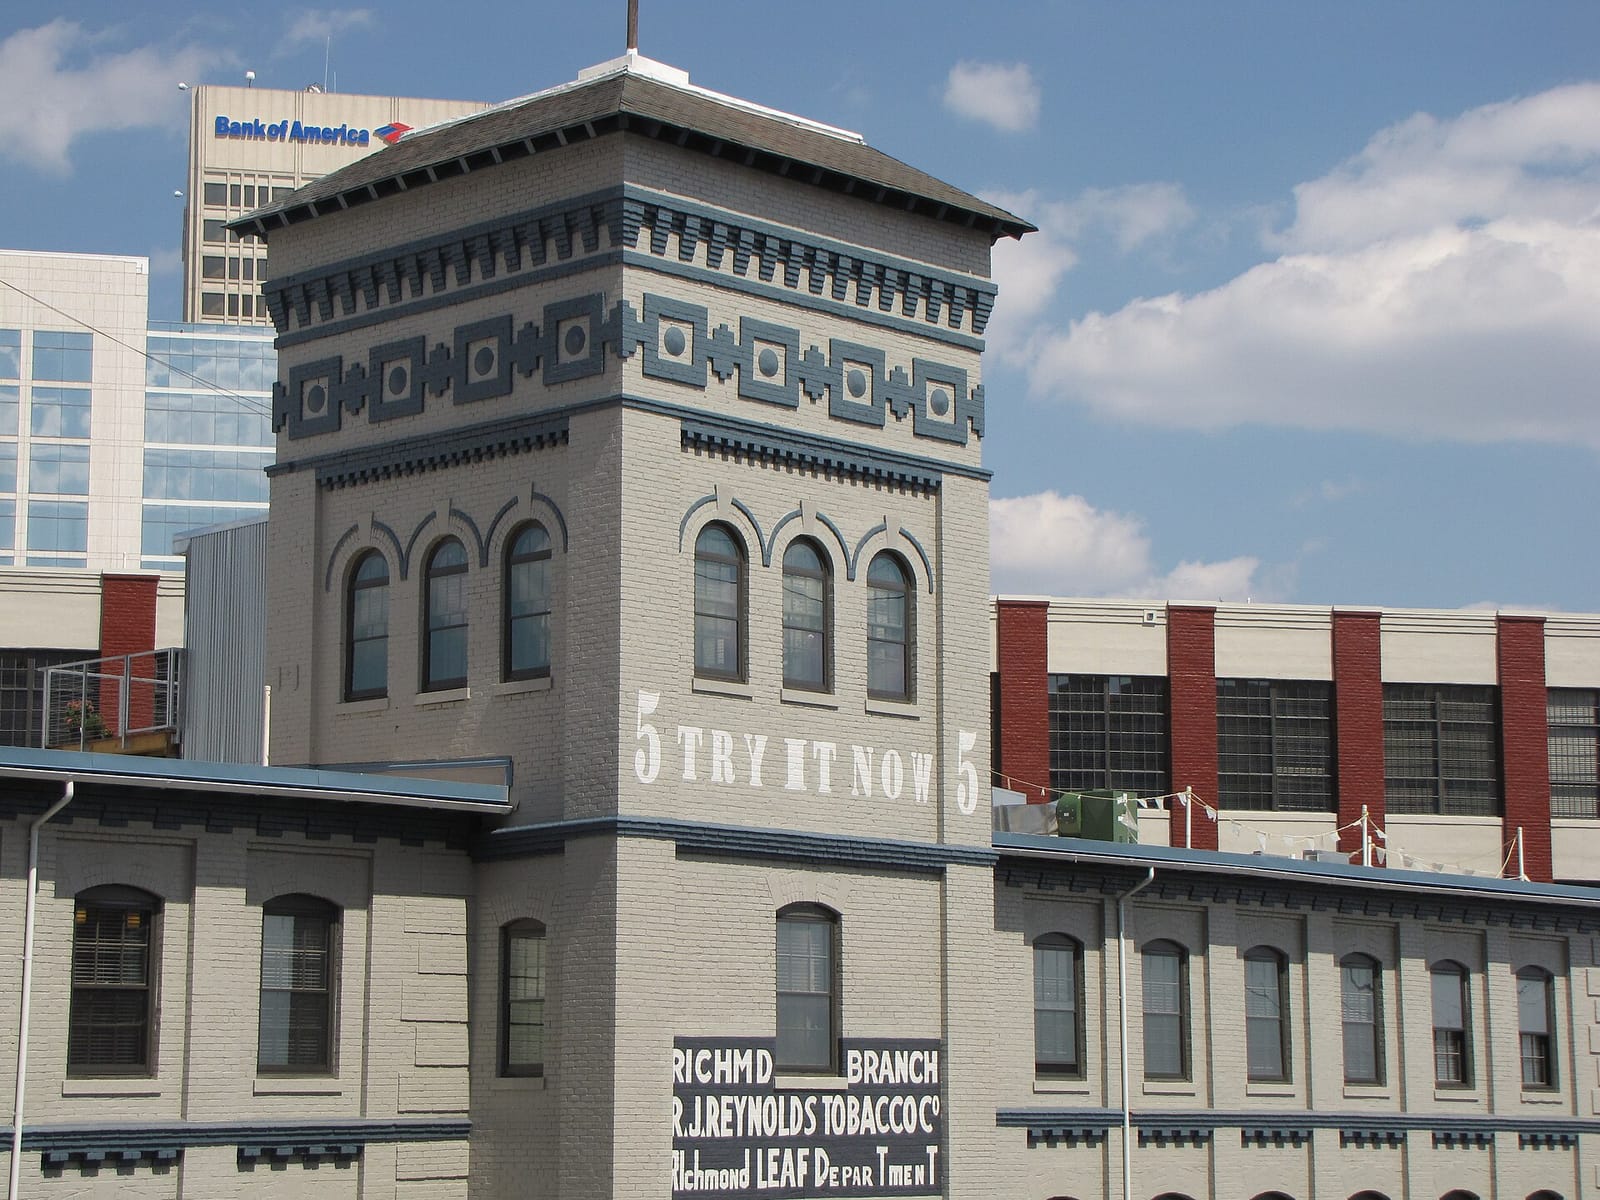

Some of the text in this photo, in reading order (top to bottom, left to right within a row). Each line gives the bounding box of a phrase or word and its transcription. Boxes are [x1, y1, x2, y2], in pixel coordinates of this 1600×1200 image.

[215, 115, 370, 147] Bank of America
[634, 690, 979, 815] 5 TRY IT NOW 5
[848, 1049, 938, 1084] BRANCH
[822, 1094, 918, 1135] TOBACCO
[757, 1147, 809, 1189] LEAF
